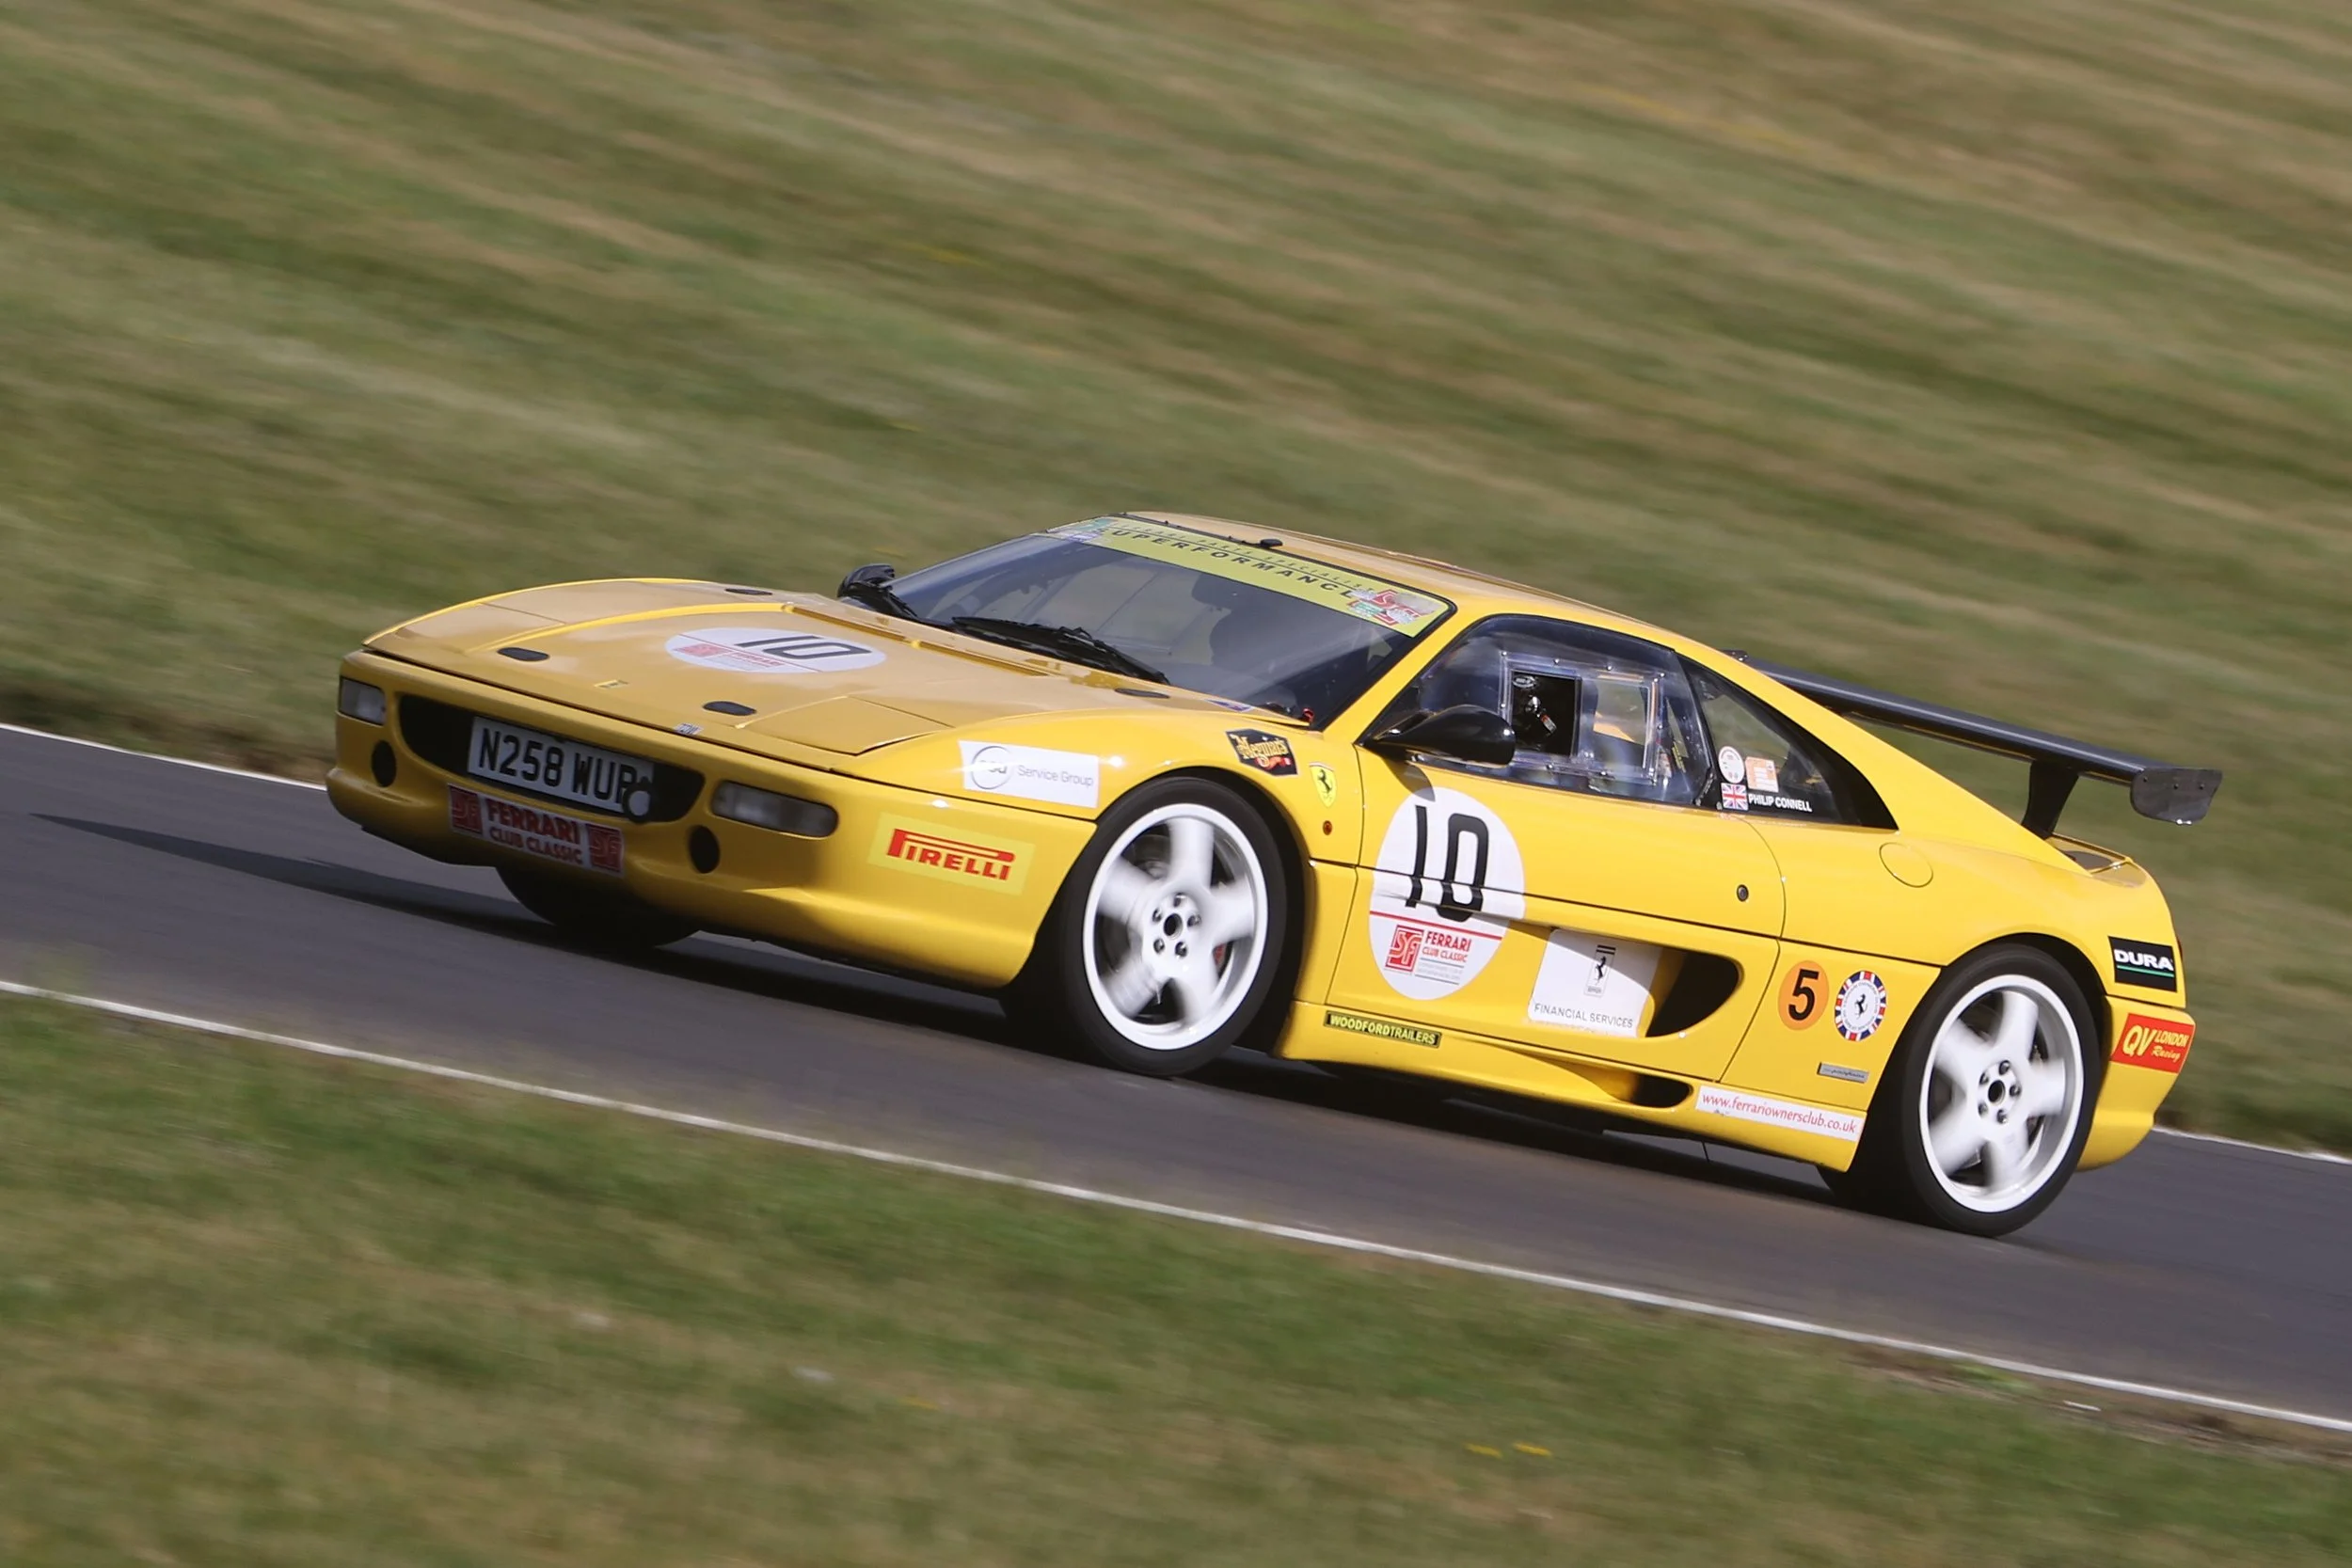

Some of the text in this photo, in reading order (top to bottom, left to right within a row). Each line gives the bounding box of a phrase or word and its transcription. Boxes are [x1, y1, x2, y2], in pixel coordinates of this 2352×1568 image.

[734, 635, 872, 659] 10
[478, 727, 564, 786] N258
[1017, 764, 1057, 782] Service
[1060, 771, 1093, 787] Group
[1748, 793, 1812, 812] PHILIP CONNELL
[485, 799, 580, 844] FERRARI
[489, 827, 582, 864] CLUB CLASSIC
[886, 828, 1015, 879] PIRELLI
[1405, 805, 1488, 922] 10
[1422, 946, 1468, 962] CLUB CLASSIC
[1425, 931, 1471, 952] FERRARI
[2113, 949, 2173, 971] DURA
[1788, 968, 1819, 1021] 5
[1534, 1003, 1633, 1027] FINANCIAL SERVICES
[2122, 1024, 2189, 1056] QV LONDON
[2152, 1045, 2180, 1062] Racing
[1702, 1090, 1856, 1133] www.ferrariownersclub.co.uk
